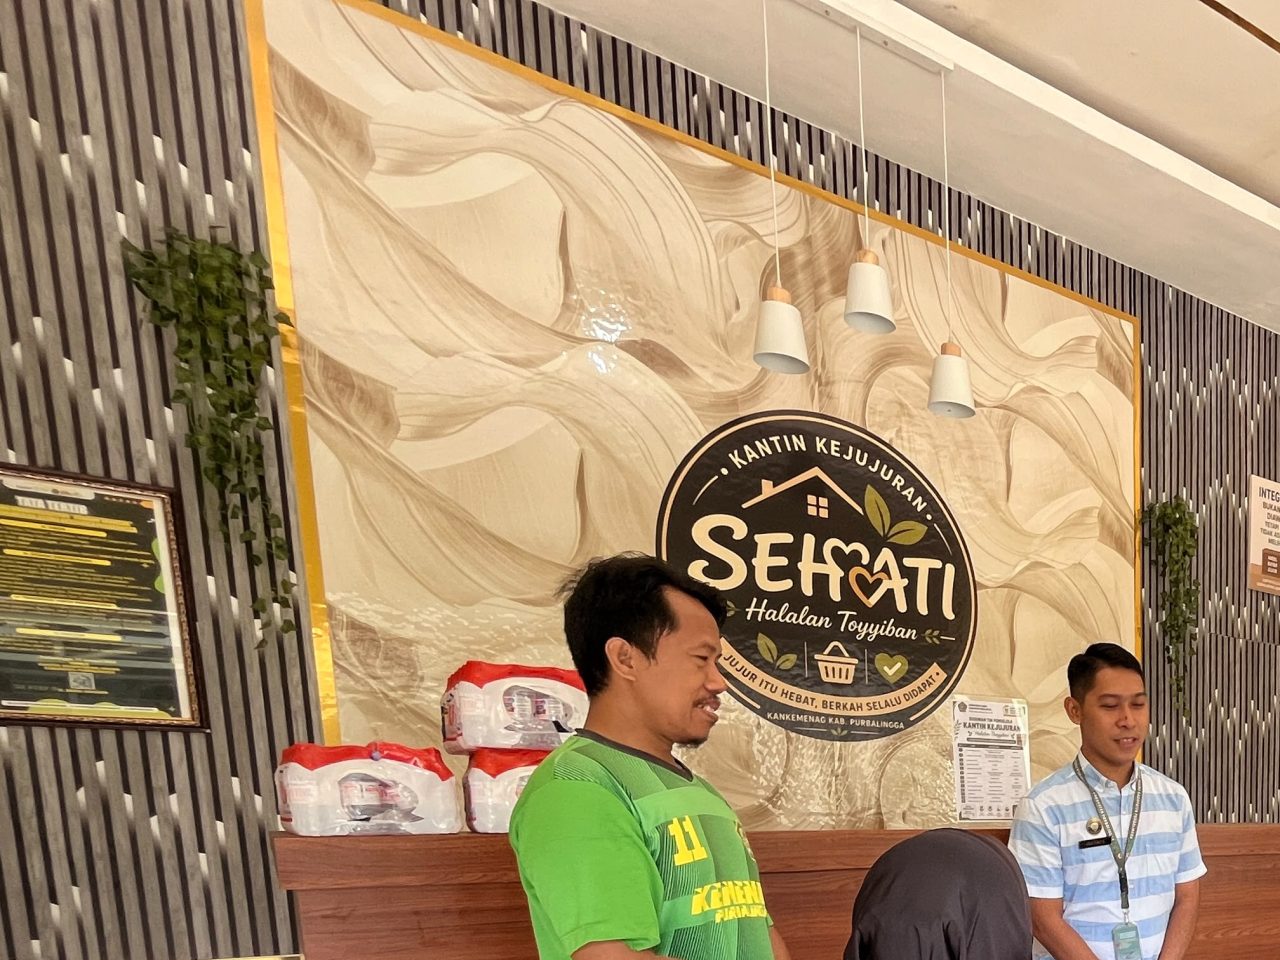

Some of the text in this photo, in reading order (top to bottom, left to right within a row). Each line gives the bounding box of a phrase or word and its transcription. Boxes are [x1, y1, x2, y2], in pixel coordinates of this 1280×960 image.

[728, 434, 927, 513] KANTIN KEJUJURAN
[745, 598, 918, 642] Halalan Toyyiban
[723, 653, 936, 712] JUJUR ITU HEBAT, BERKAH SELALU DIDAPAT
[767, 711, 905, 729] KANKEMENAG KAB. PURBALINGGA
[667, 815, 708, 866] 11
